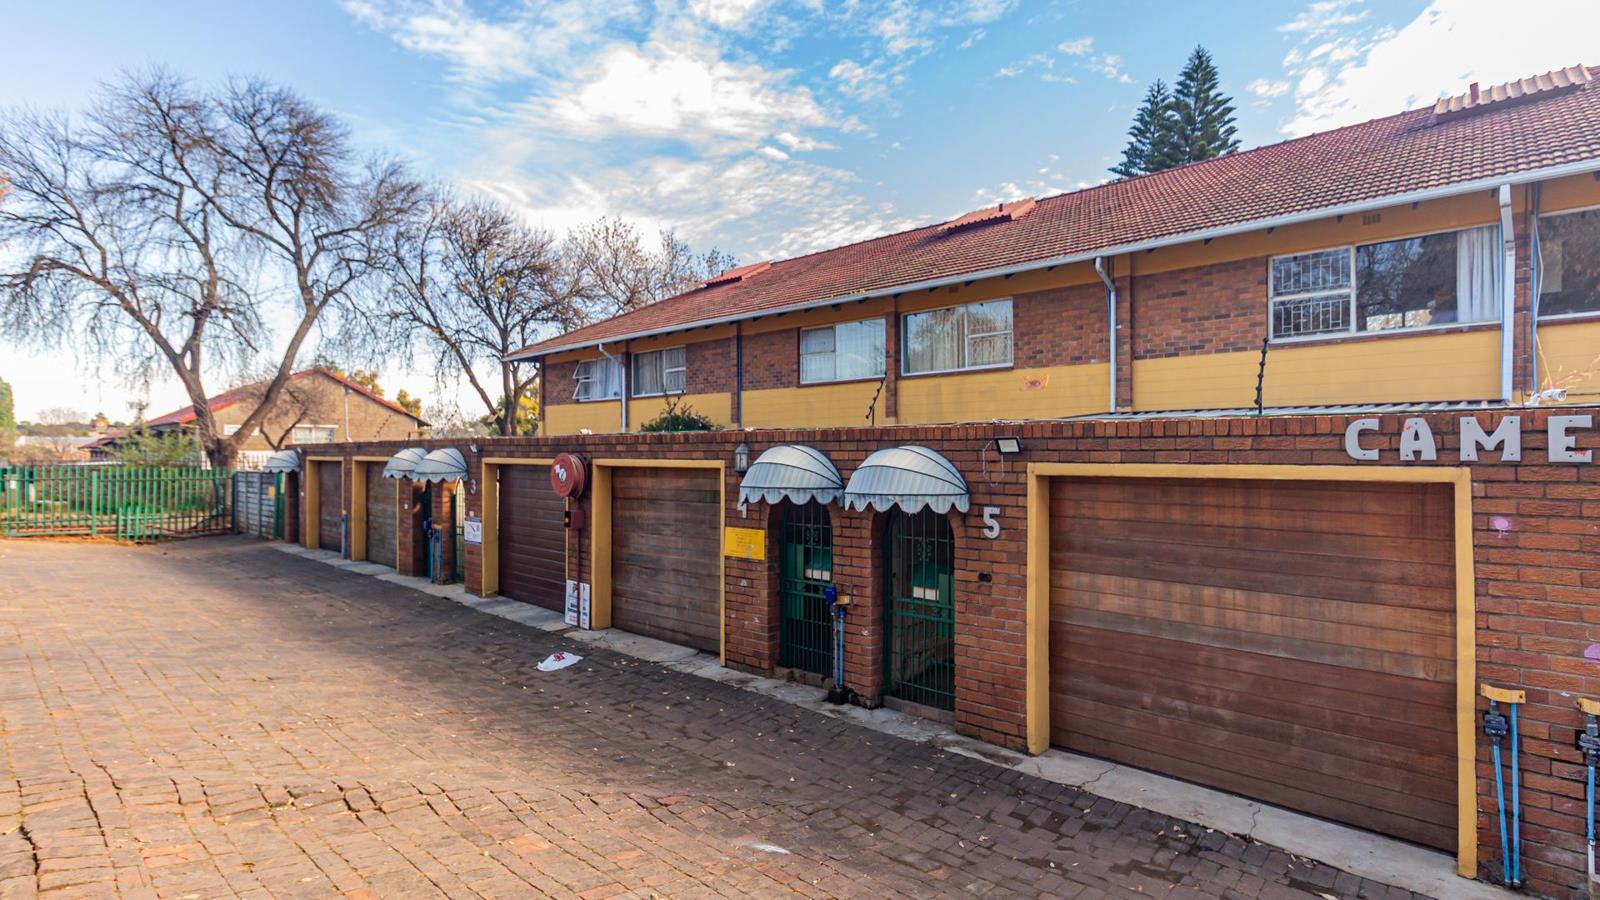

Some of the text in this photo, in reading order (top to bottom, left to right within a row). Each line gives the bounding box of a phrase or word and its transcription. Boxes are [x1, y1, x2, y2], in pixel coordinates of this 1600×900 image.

[1345, 415, 1592, 462] CAME
[470, 479, 476, 494] 3
[983, 507, 1000, 539] 5
